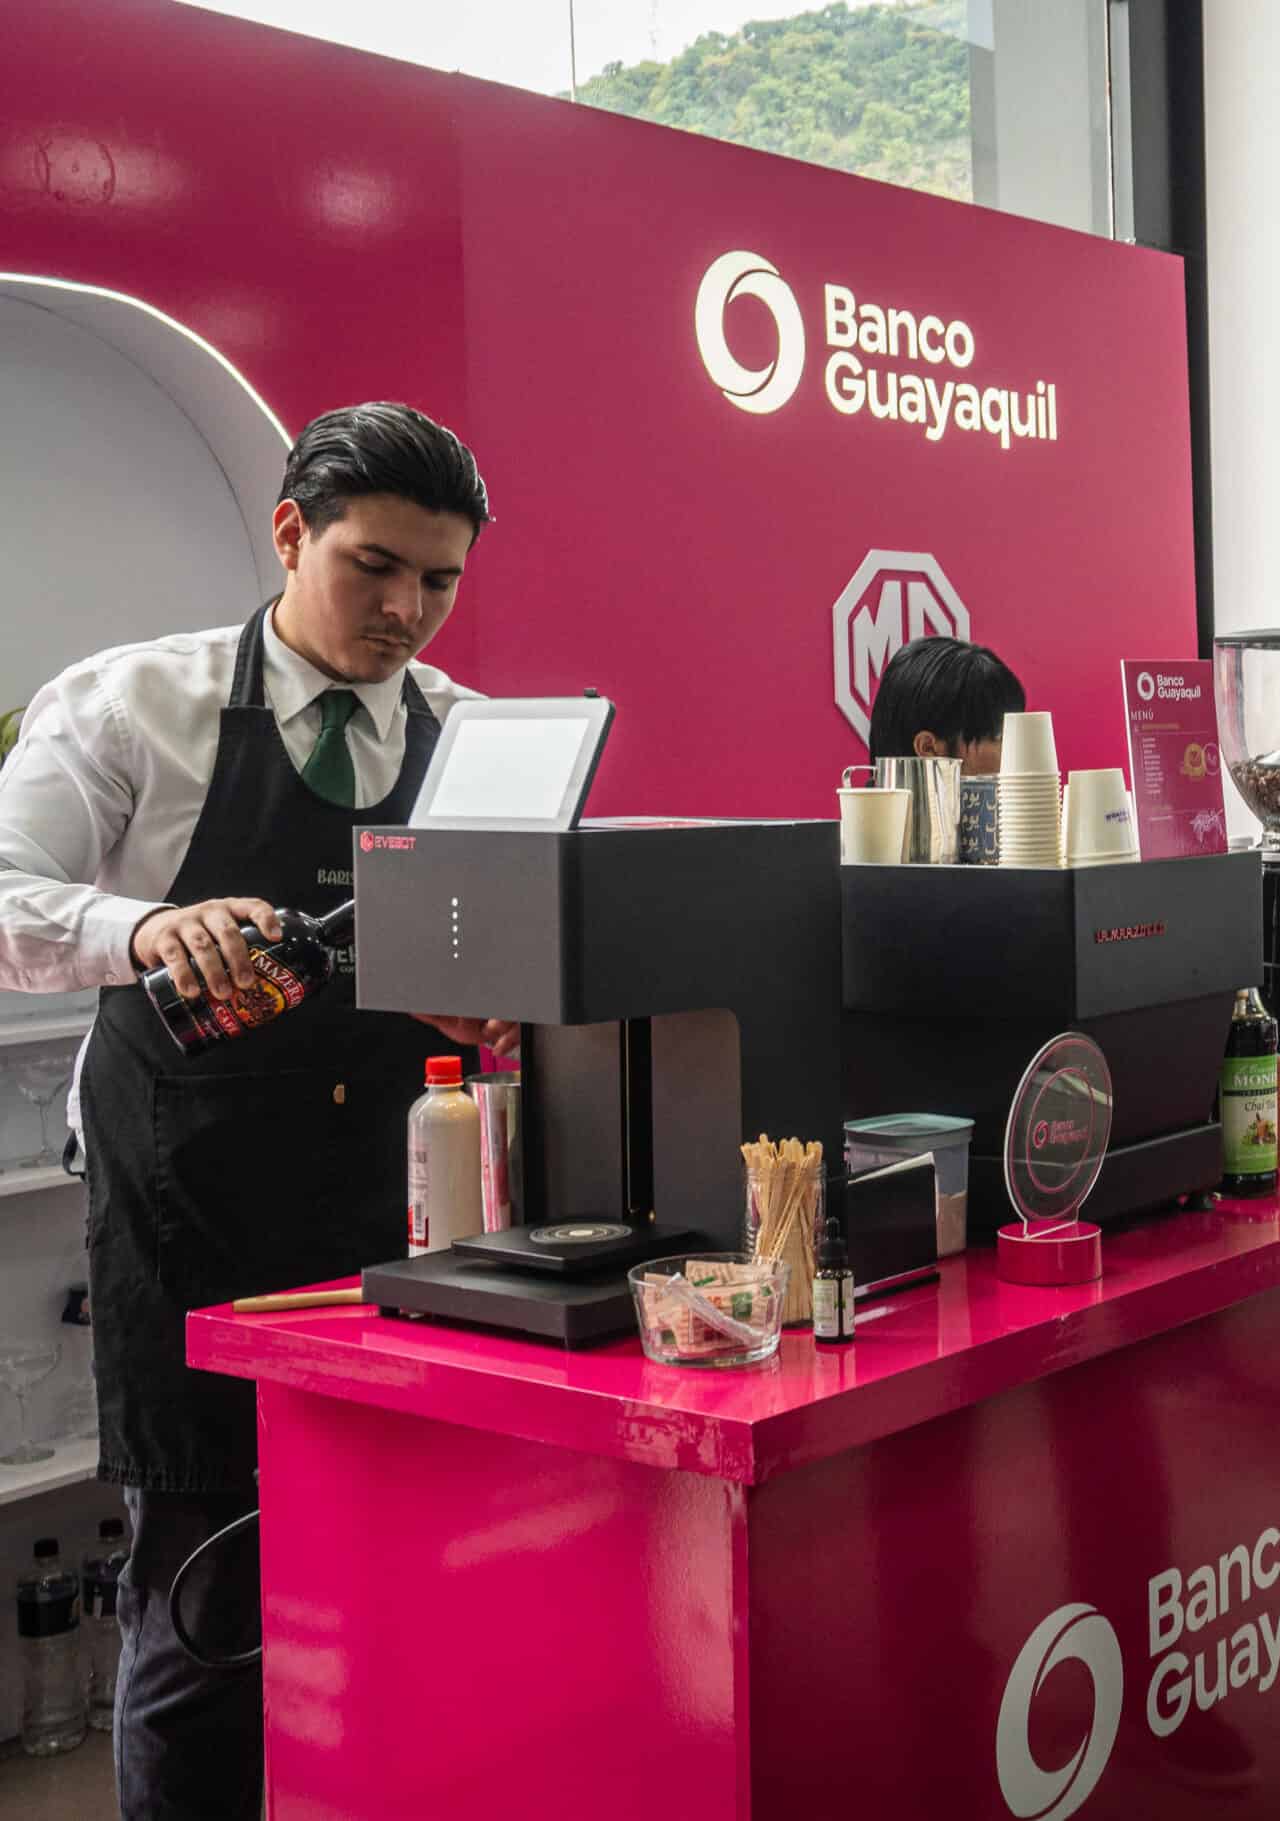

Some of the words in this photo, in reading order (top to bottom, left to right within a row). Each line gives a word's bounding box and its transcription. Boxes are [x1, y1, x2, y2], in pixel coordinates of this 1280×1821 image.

[824, 283, 976, 369] Banco
[825, 350, 1058, 450] Guayaquil
[1156, 673, 1185, 687] Banco
[1157, 685, 1202, 702] Guayaquil
[1131, 708, 1154, 721] MENÚ
